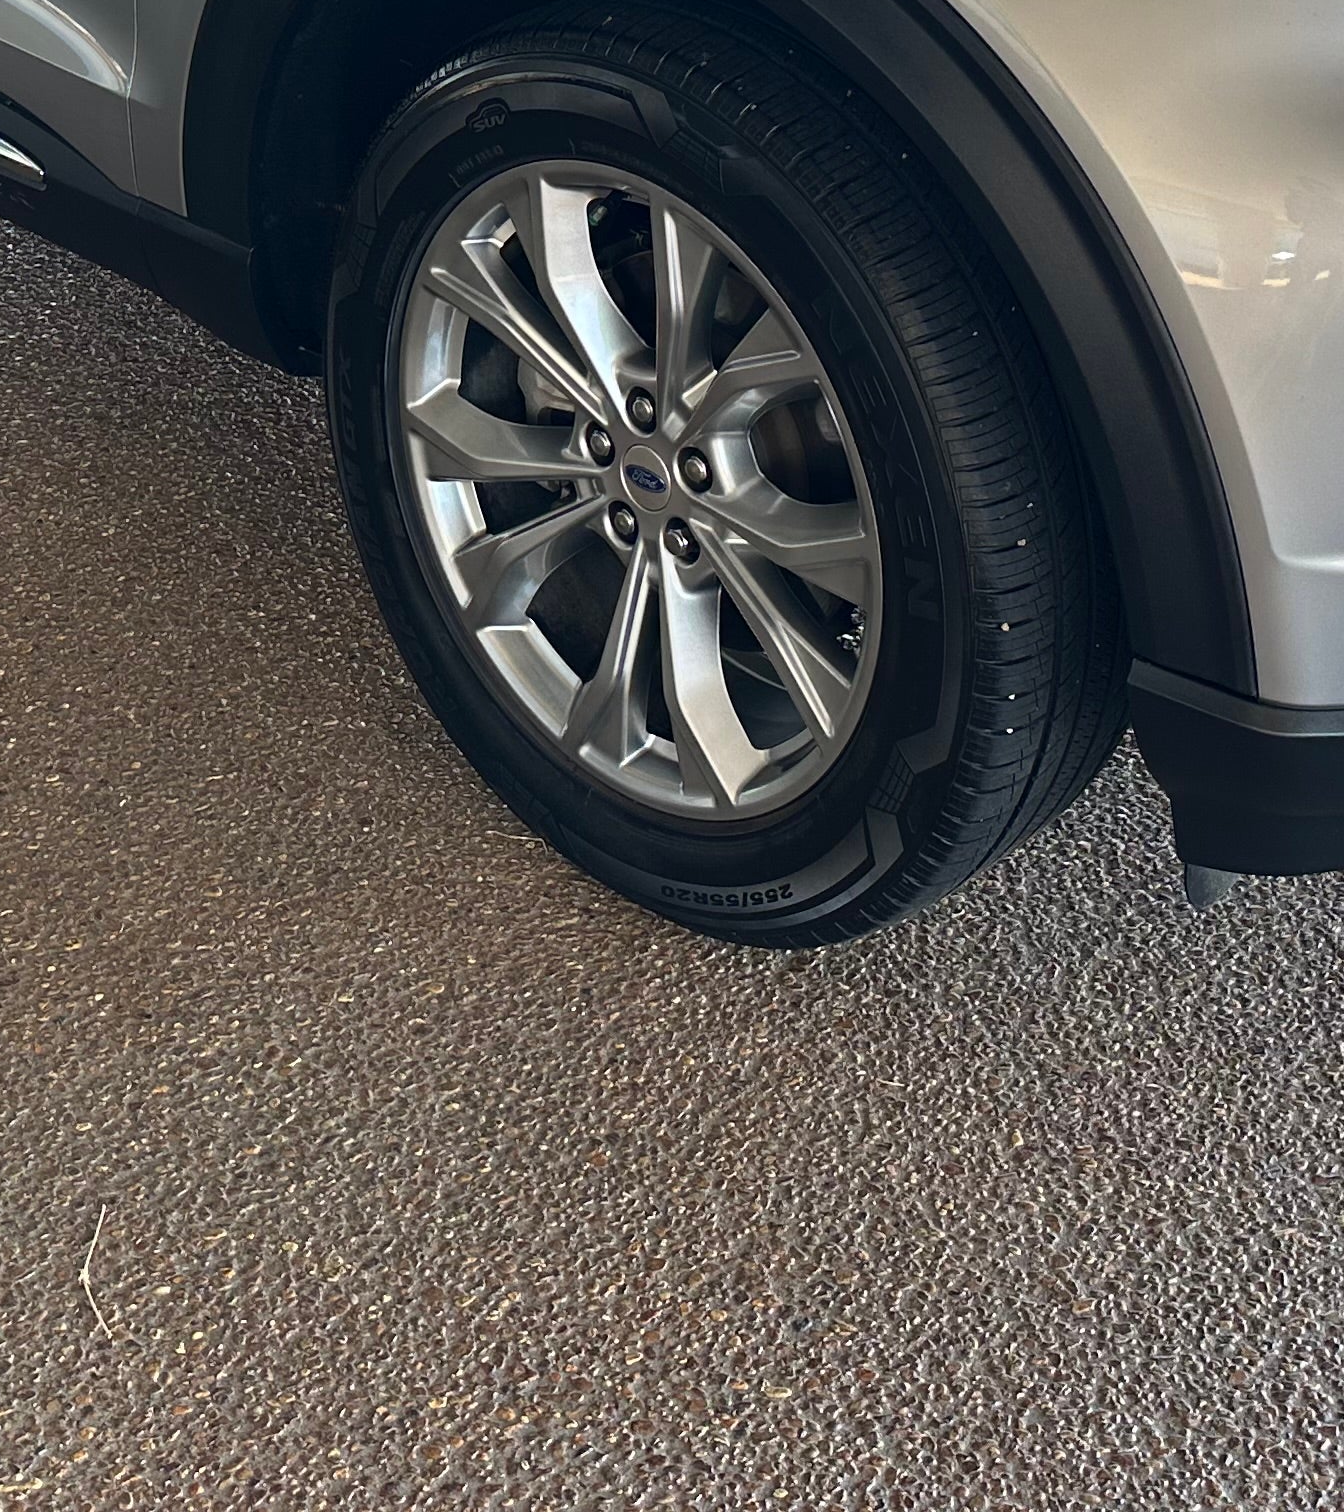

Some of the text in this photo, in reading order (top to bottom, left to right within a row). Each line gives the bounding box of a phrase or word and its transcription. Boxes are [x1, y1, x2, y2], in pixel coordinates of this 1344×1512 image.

[472, 114, 506, 133] SUV
[630, 468, 660, 489] Ford
[660, 883, 794, 908] 255/55R20
